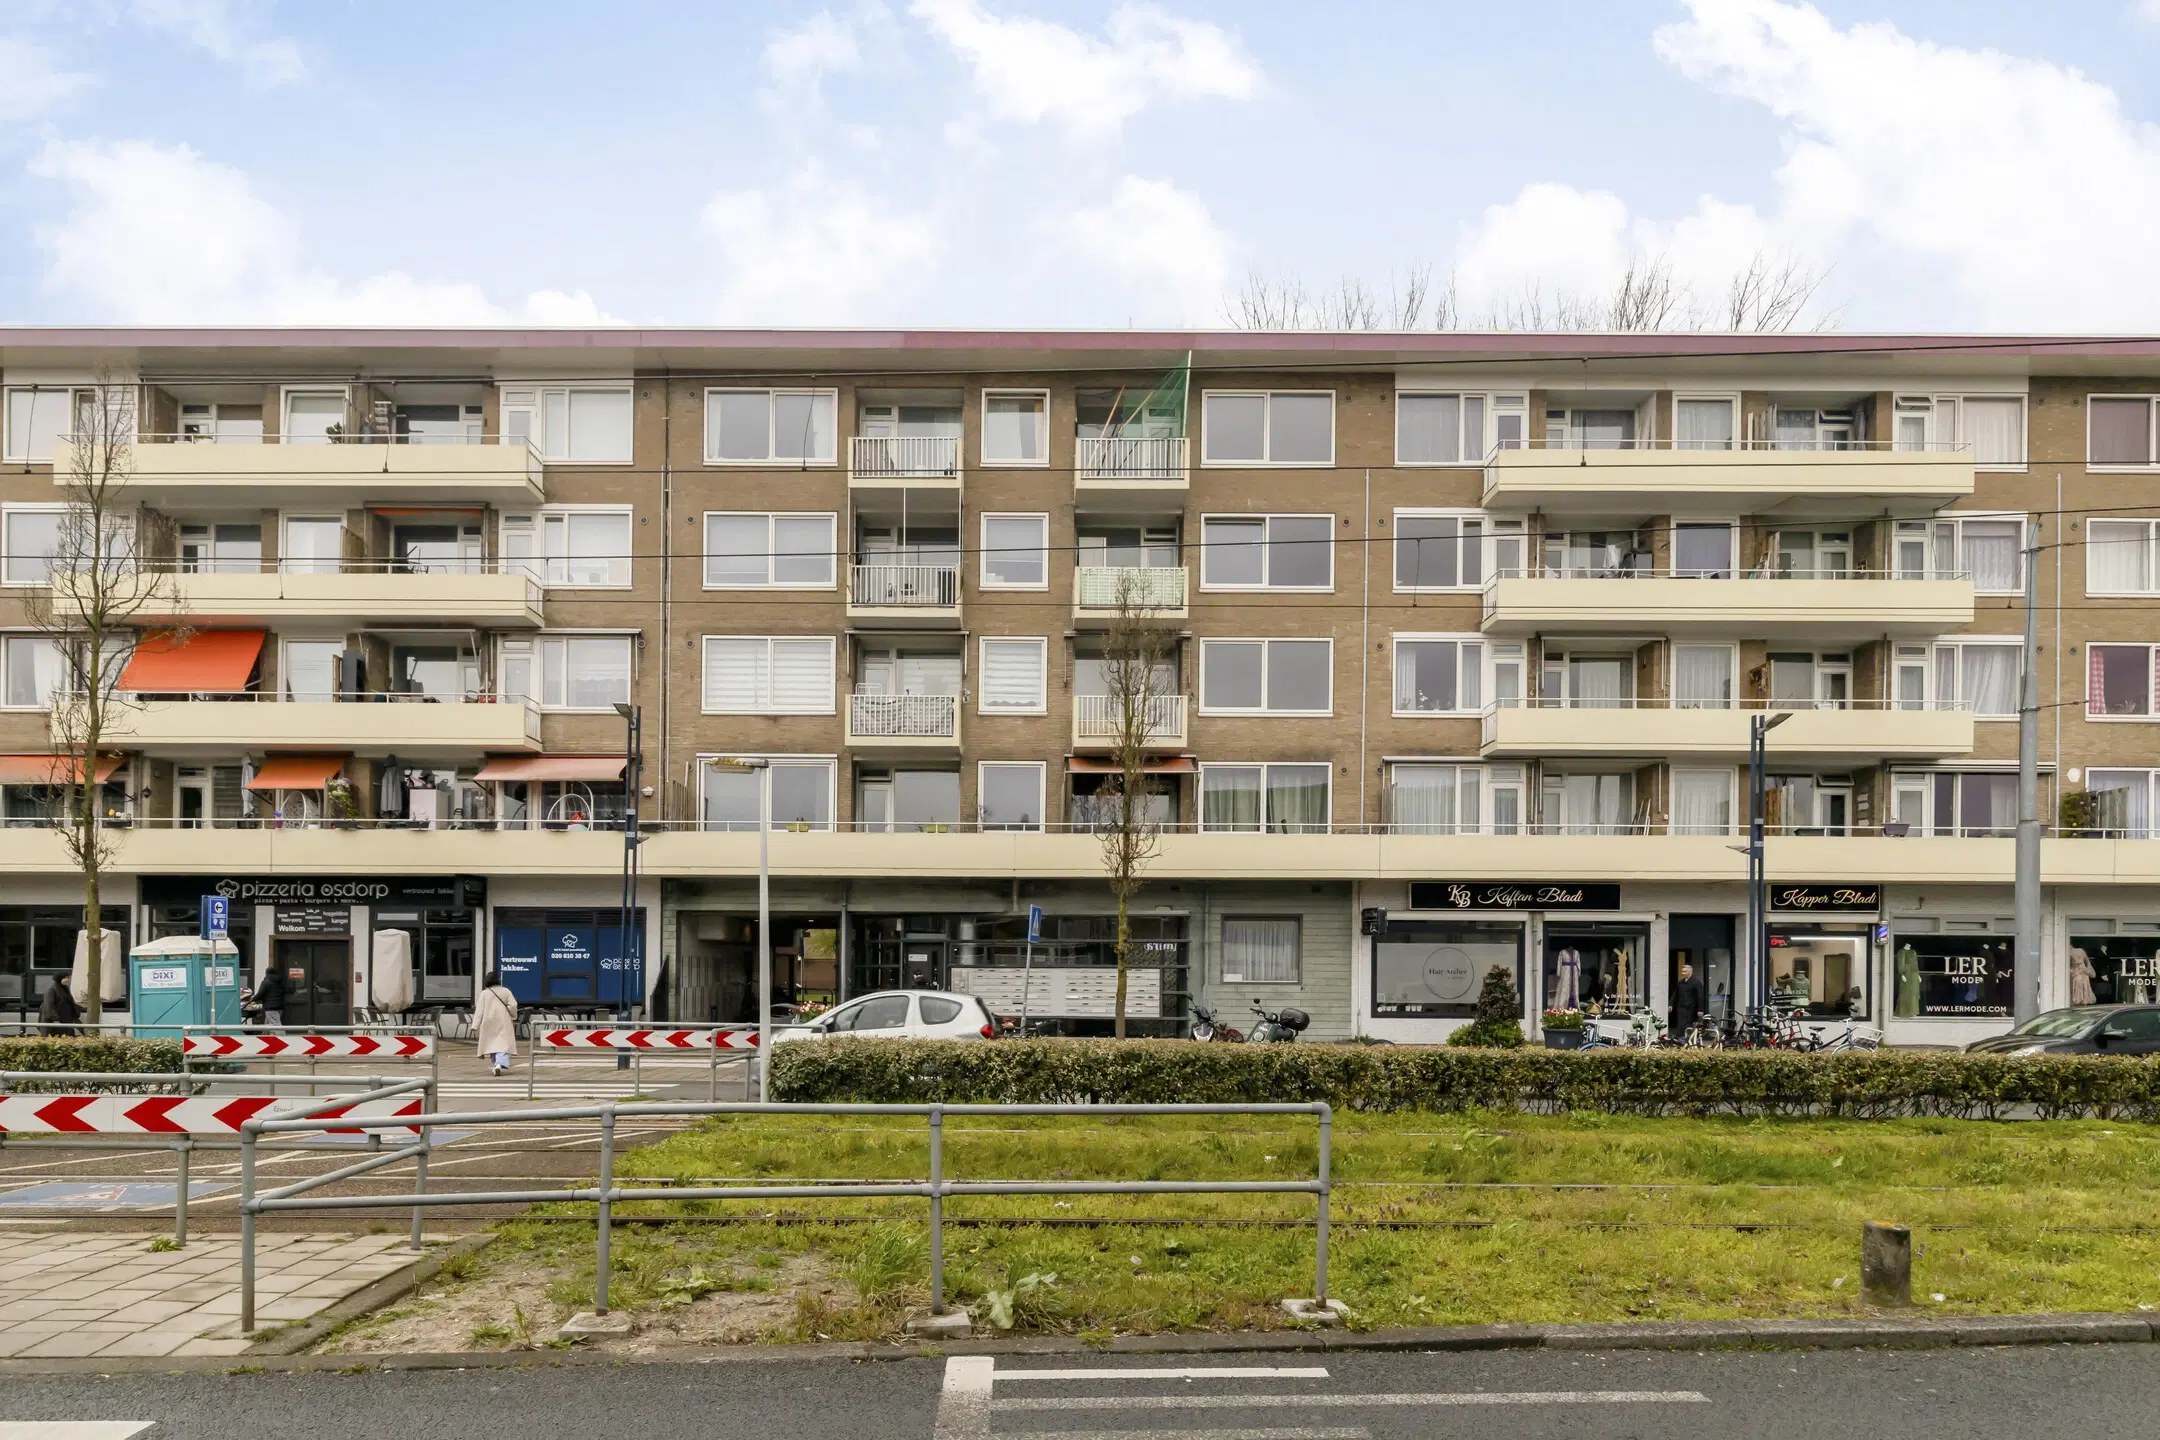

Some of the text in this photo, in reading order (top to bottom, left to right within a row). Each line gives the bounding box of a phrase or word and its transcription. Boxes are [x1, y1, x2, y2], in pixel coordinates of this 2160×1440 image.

[242, 881, 389, 899] pizzeria osdorp
[1536, 887, 1584, 903] Bladi
[1773, 888, 1877, 908] Kapper Bladi
[500, 955, 538, 963] vertrouwd
[1943, 956, 1988, 975] LER
[2121, 958, 2160, 977] LER
[1952, 976, 1981, 984] MODE
[2128, 978, 2157, 986] MODE
[1926, 1004, 2007, 1013] WWW.LERMODE.COM
